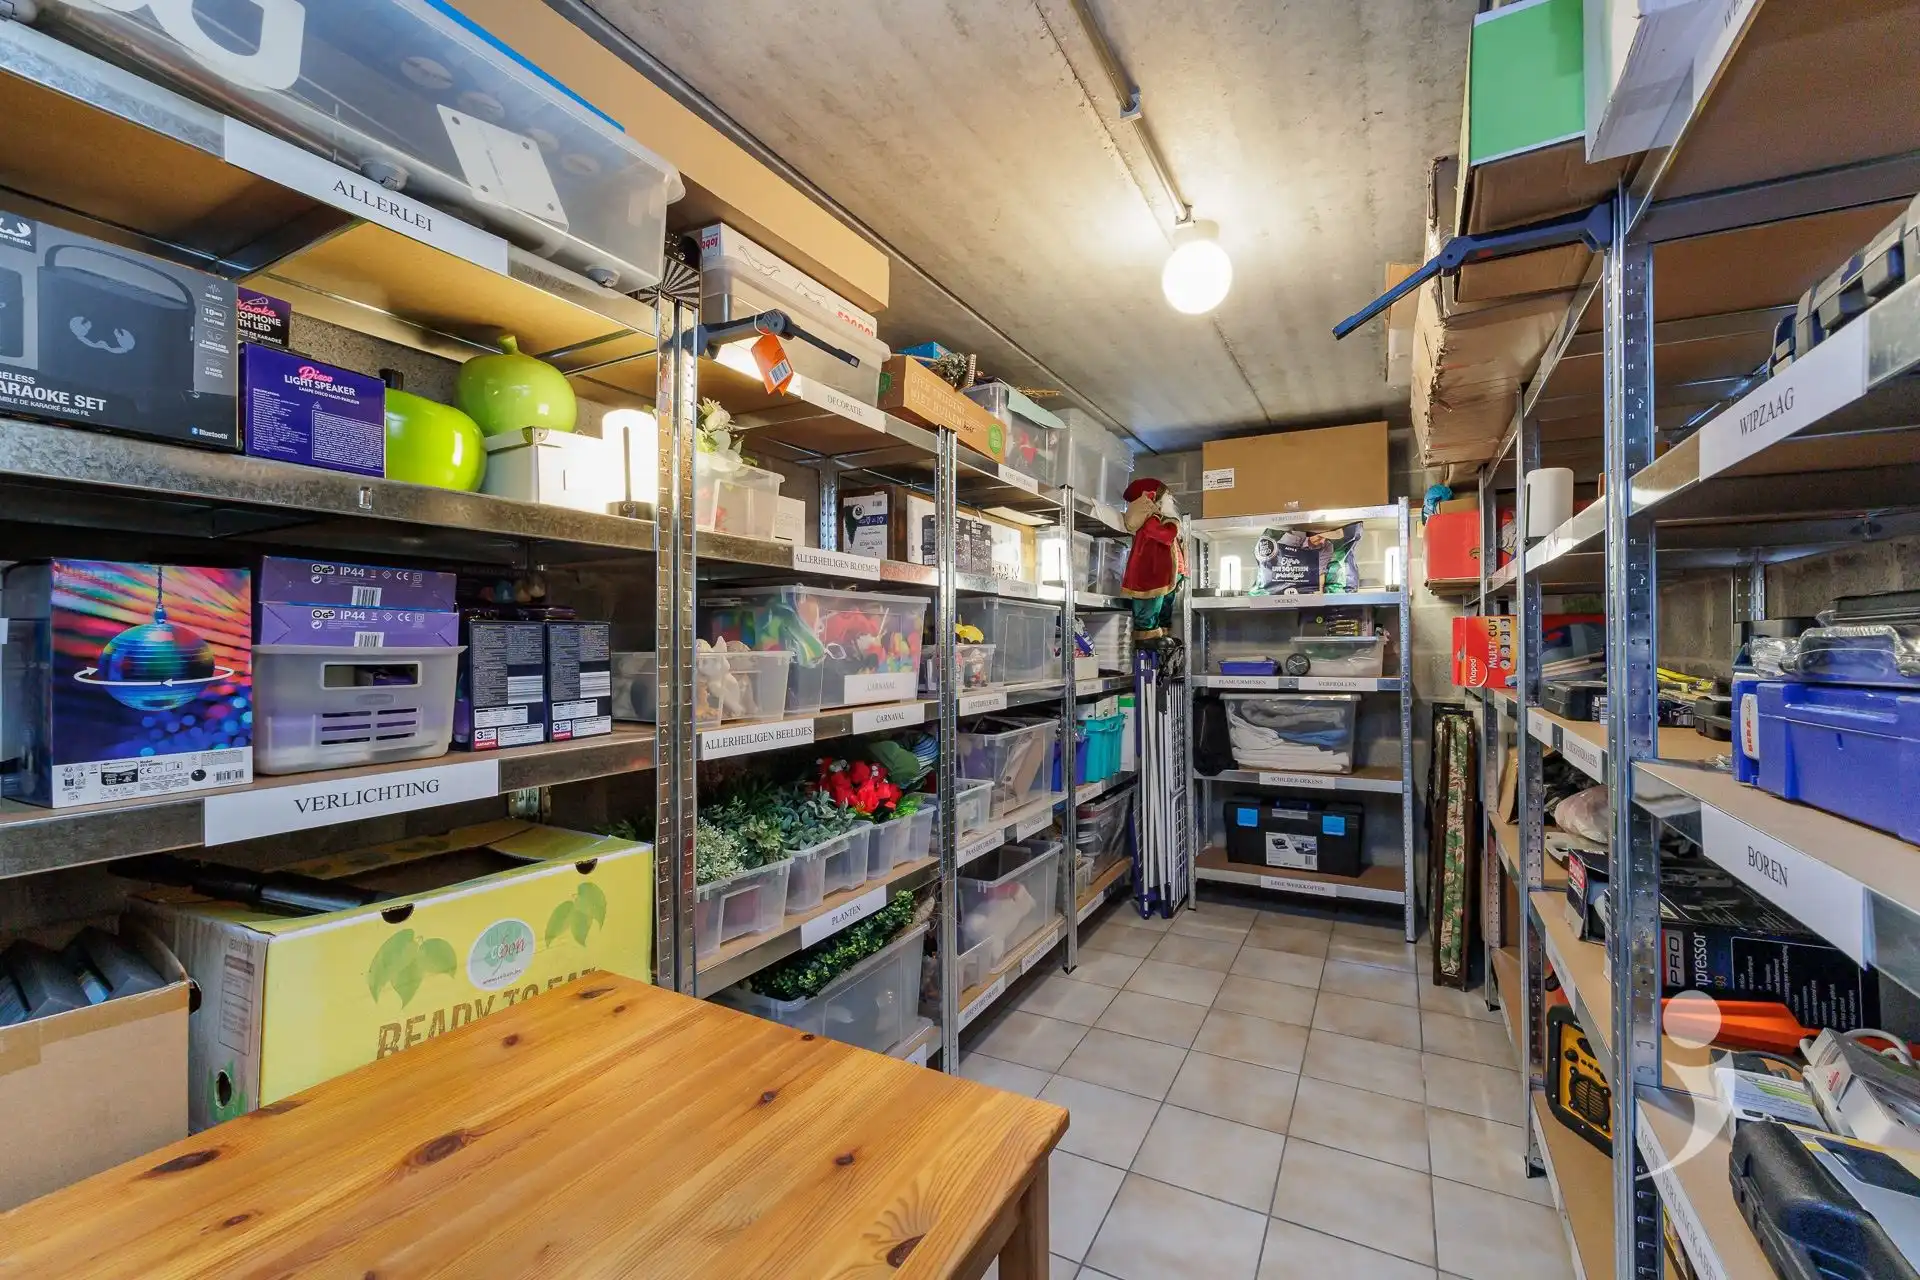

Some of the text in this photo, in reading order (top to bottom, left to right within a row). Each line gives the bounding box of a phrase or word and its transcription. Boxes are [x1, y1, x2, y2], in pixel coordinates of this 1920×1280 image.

[333, 178, 433, 233] ALLERLEI
[240, 311, 282, 327] OPHONE
[240, 319, 252, 329] TH
[253, 320, 271, 332] LED
[0, 371, 36, 385] ELESS
[299, 366, 333, 383] Disco
[284, 374, 356, 397] LIGHT SPEAKER
[298, 386, 313, 395] LAMPE
[313, 389, 328, 398] DISCO
[0, 381, 107, 411] ARAOKE SET
[827, 394, 863, 417] DECORATIE
[62, 406, 80, 415] SANS
[1739, 386, 1796, 437] WIPZAAG
[199, 428, 228, 440] Bluetooth
[340, 566, 365, 577] IP44
[795, 553, 879, 573] ALLERHEILIGEN BLOEMEN
[340, 610, 366, 621] IP44
[1469, 657, 1479, 685] Maped
[554, 721, 561, 731] 3
[876, 711, 905, 724] CARNAVAL
[476, 731, 484, 740] 3
[704, 726, 813, 750] ALLERHEILIGEN BEELDJES
[293, 778, 441, 815] VERLICHTING
[1747, 845, 1789, 888] BOREN
[831, 903, 862, 926] PLANTEN
[1669, 936, 1681, 985] PRO
[1661, 1168, 1718, 1280] VERLENGKABE
